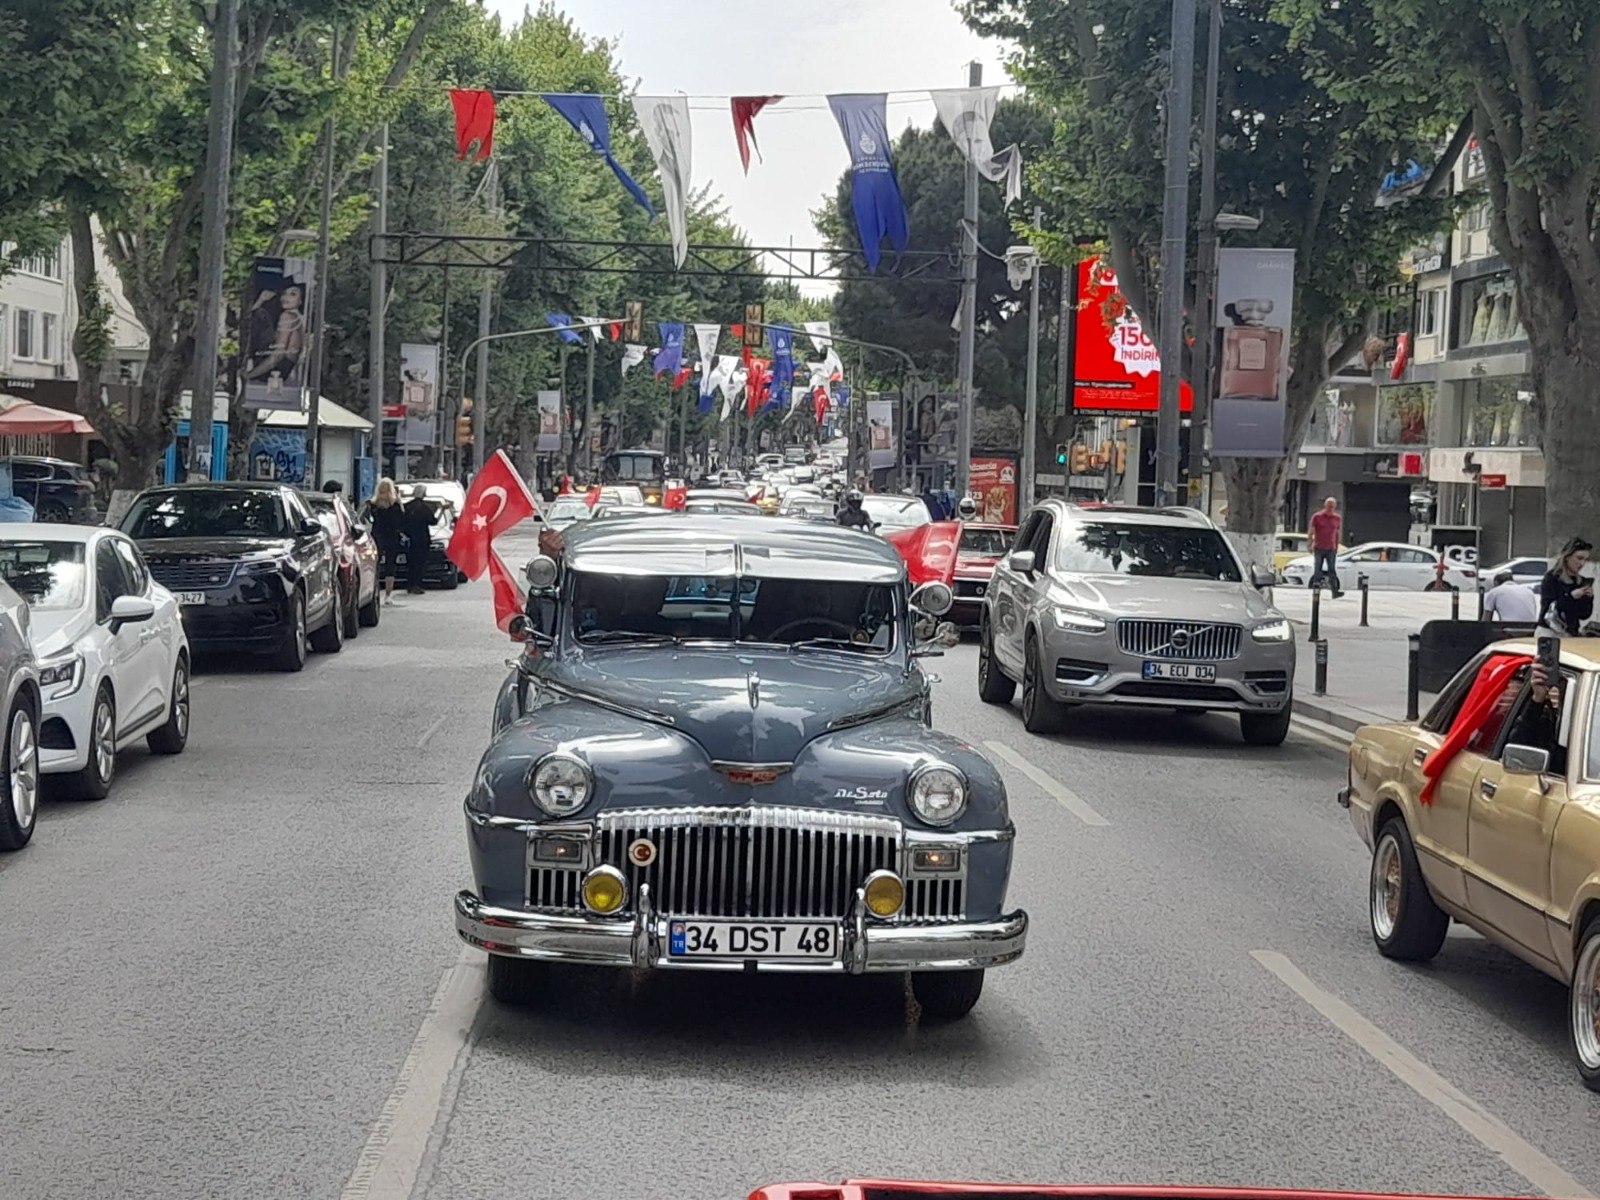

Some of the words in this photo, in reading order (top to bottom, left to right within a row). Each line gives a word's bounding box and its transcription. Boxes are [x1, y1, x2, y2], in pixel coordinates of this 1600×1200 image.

[1150, 663, 1163, 676] 34
[1170, 664, 1189, 677] ECU
[1195, 666, 1213, 679] 034
[673, 939, 684, 948] TR
[686, 926, 718, 952] 34
[729, 926, 786, 953] DST
[797, 926, 830, 953] 48
